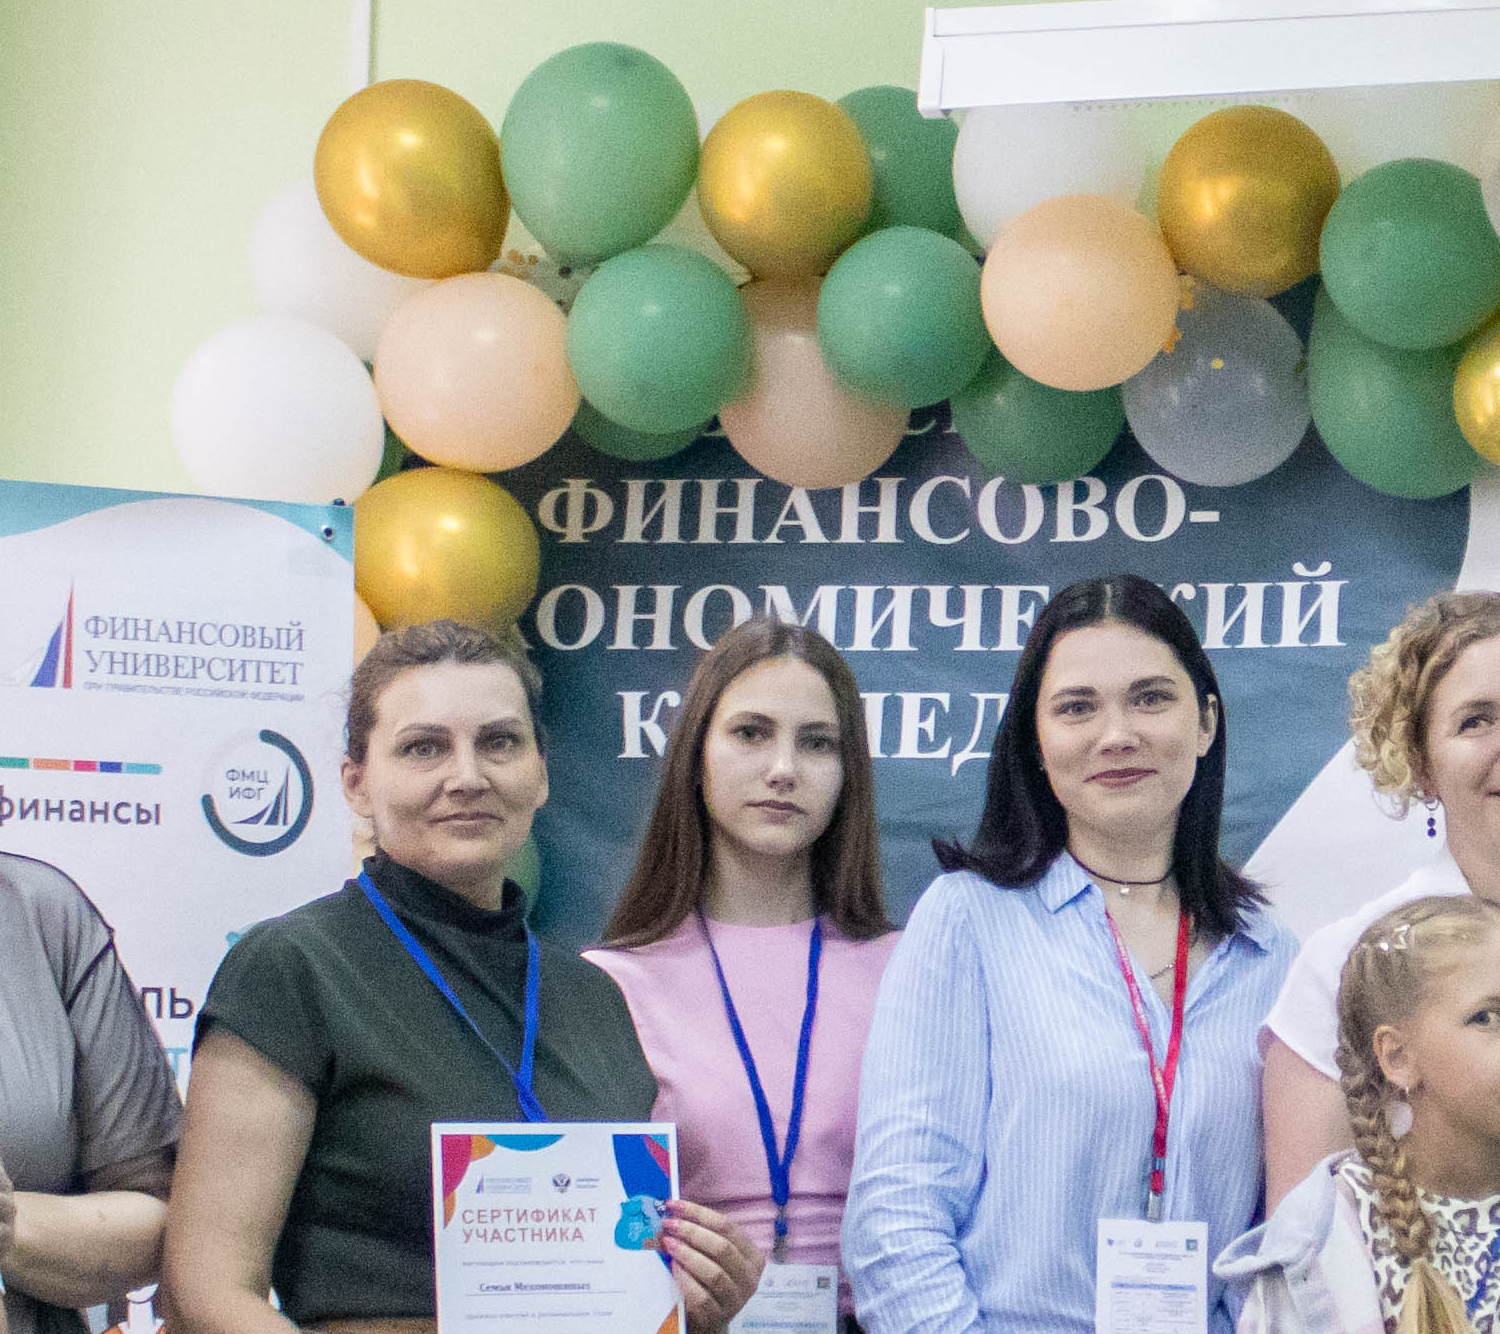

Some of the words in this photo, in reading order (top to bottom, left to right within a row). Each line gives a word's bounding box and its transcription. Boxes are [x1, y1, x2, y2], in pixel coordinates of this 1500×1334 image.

[537, 474, 1221, 545] ФИНАНСОВО-
[84, 615, 306, 652] ФИНАНСОВЫЙ
[84, 649, 305, 685] УНИВЕРСИТЕТ
[226, 768, 269, 786] ФМЦ
[229, 786, 266, 802] ИФГ
[461, 1207, 597, 1225] СЕРТИФИКАТ
[462, 1227, 585, 1244] УЧАСТНИКА
